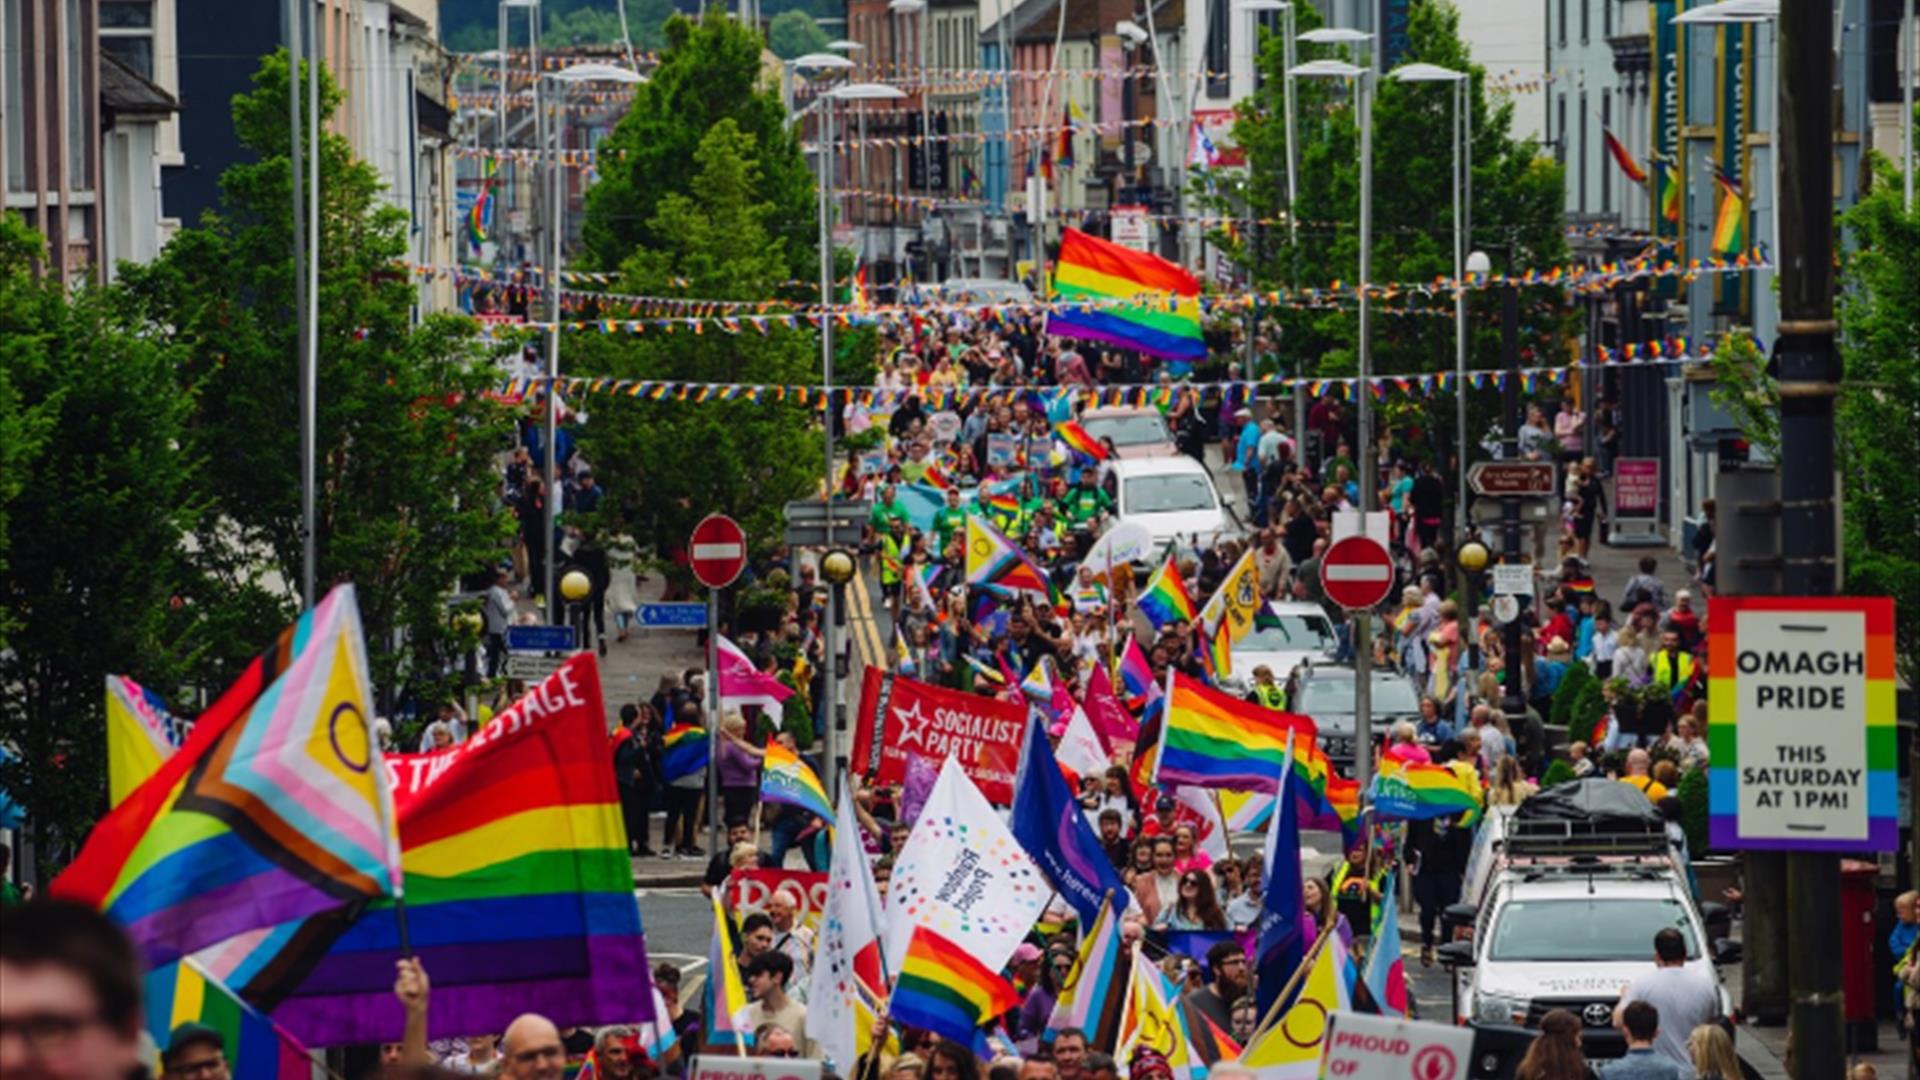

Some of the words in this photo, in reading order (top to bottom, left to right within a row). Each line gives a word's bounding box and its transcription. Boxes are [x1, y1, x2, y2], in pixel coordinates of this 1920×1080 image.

[1737, 650, 1864, 675] OMAGH
[1757, 686, 1845, 710] PRIDE
[931, 707, 1022, 745] SOCIALIST
[925, 730, 984, 763] PARTY
[1776, 745, 1827, 763] THIS
[1742, 768, 1862, 786] SATURDAY
[1756, 791, 1783, 808] AT
[1792, 791, 1848, 809] 1PM!
[1335, 1032, 1410, 1056] PROUD
[1330, 1059, 1360, 1076] OF
